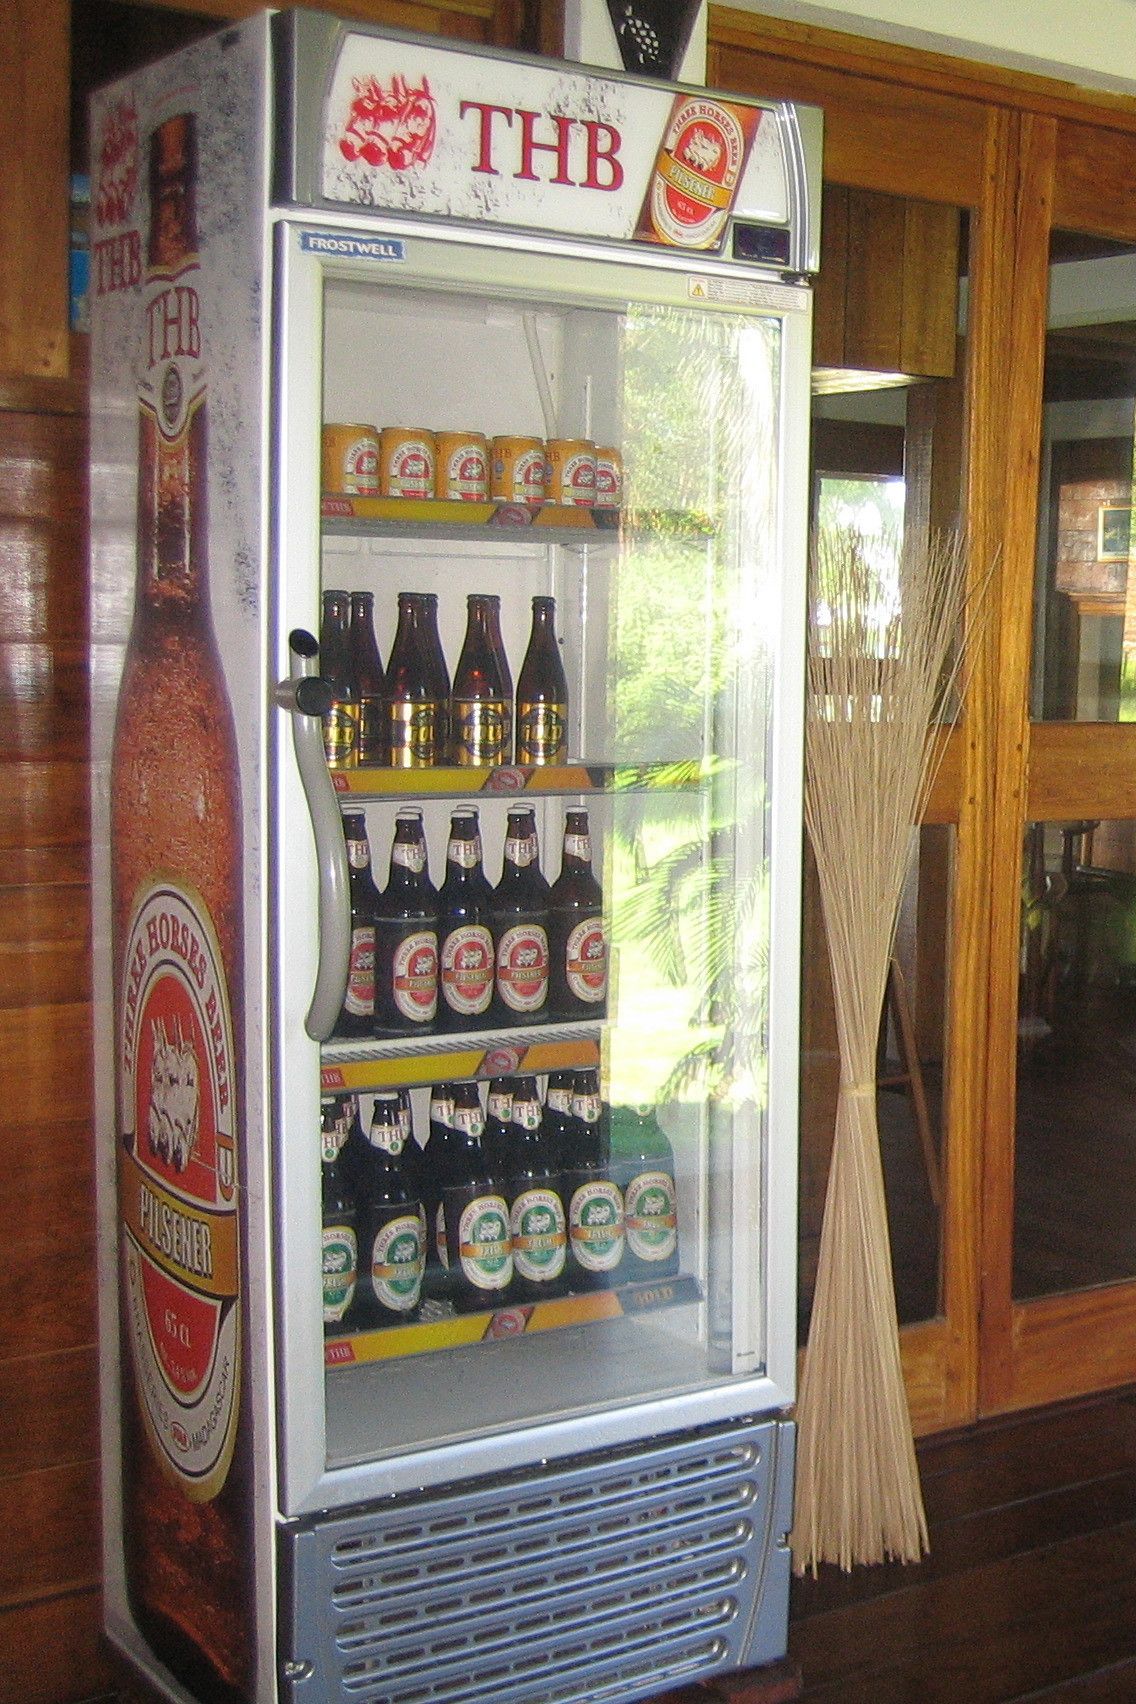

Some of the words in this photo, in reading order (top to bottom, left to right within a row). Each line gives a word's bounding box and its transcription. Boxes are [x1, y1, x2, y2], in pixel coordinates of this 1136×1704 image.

[459, 100, 626, 192] THB
[308, 235, 398, 257] FROSTWELL
[146, 912, 207, 990] HORSES
[139, 1183, 214, 1278] PILSENER
